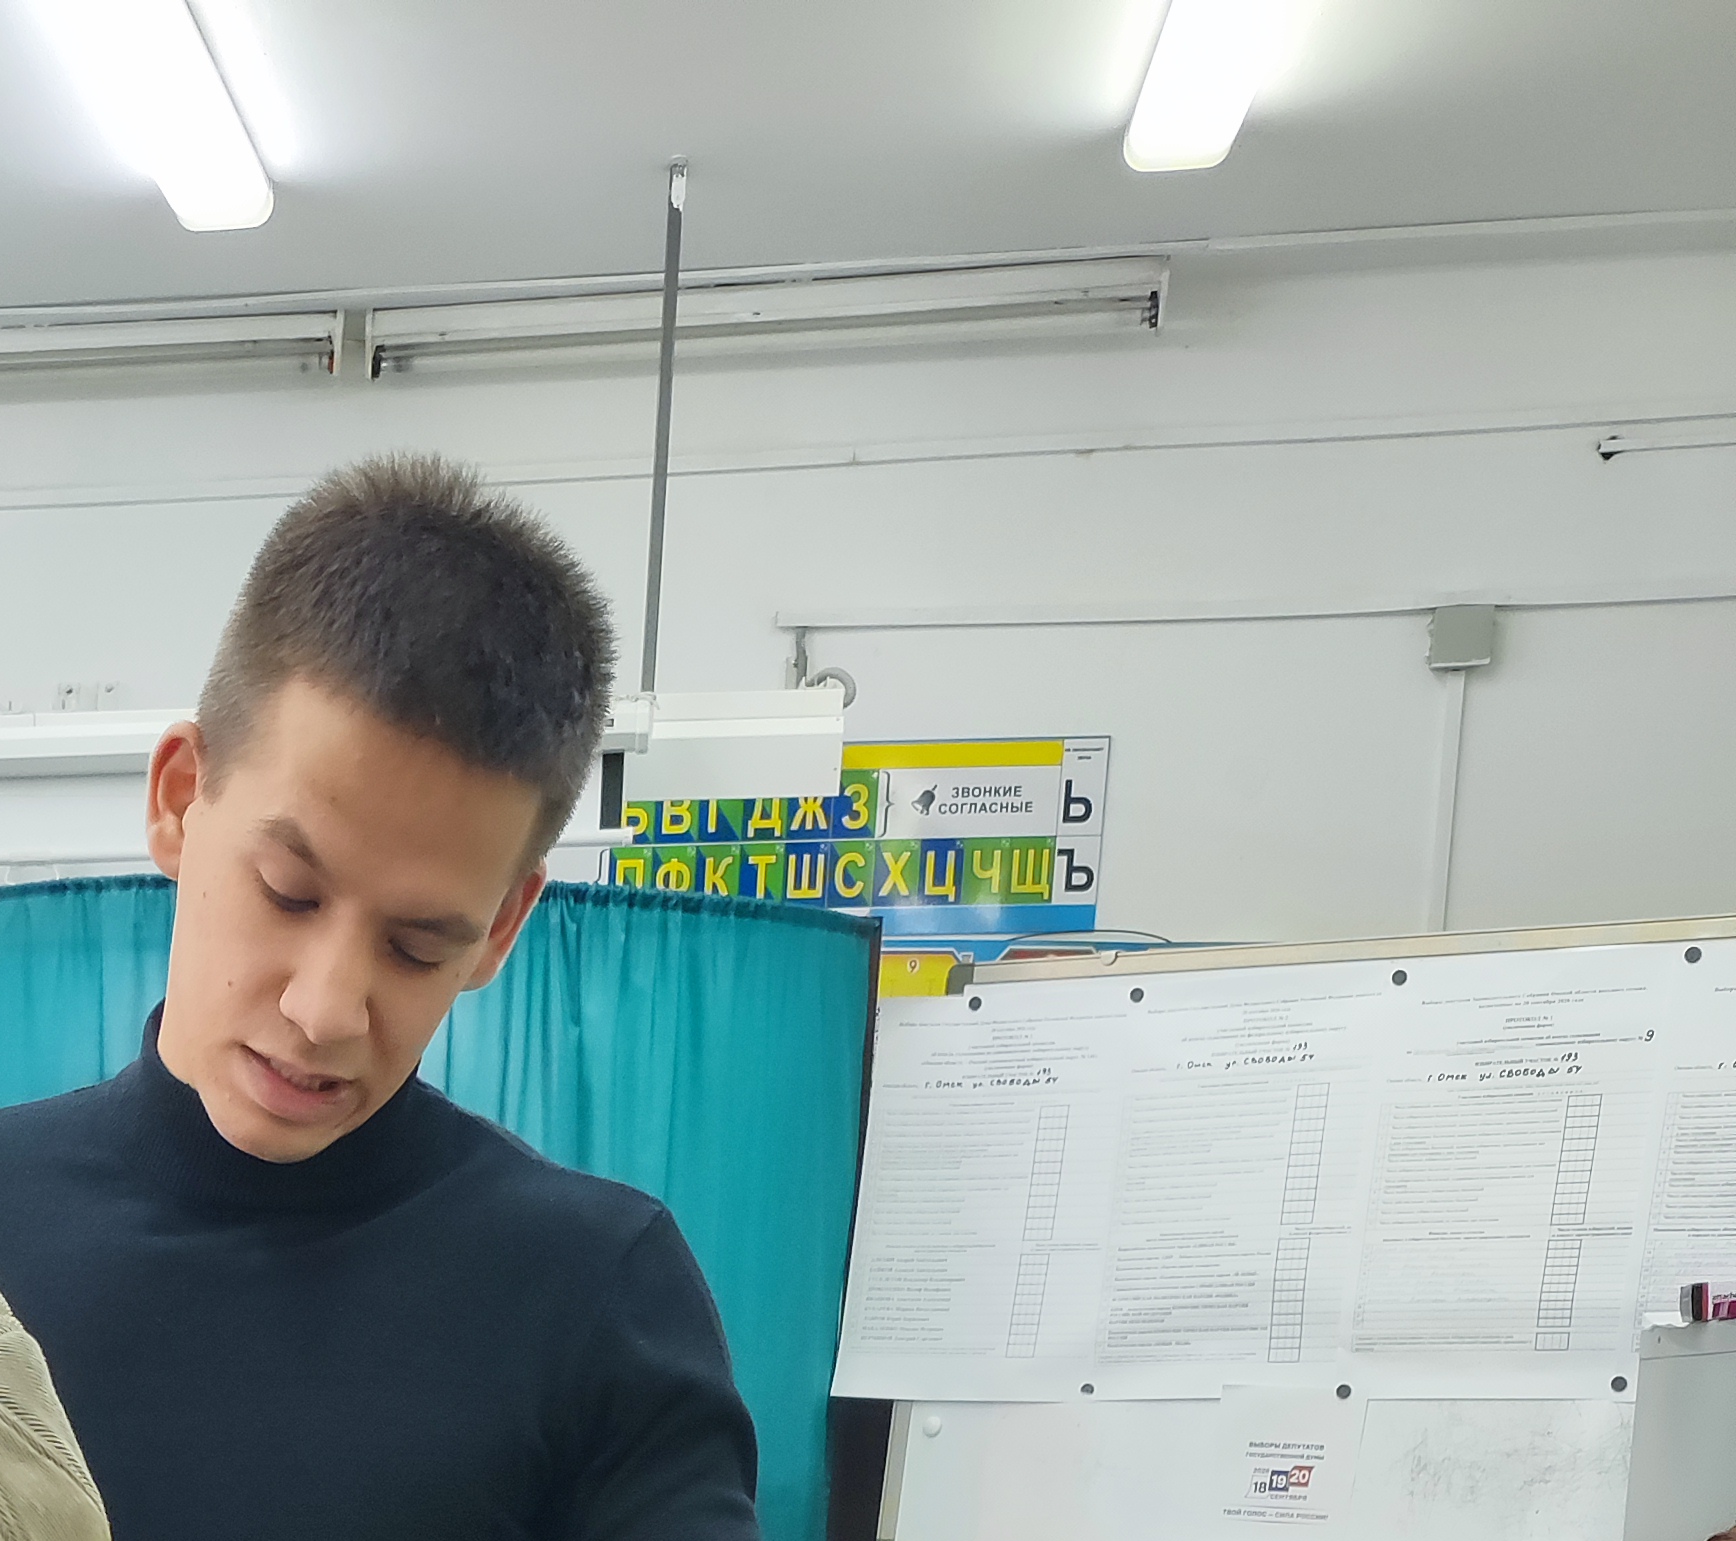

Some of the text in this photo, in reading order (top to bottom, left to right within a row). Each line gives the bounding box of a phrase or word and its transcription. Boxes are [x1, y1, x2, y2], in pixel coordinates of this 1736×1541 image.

[841, 783, 869, 830] З
[938, 801, 1033, 815] СОГЛАСНЫЕ
[951, 785, 1023, 798] ЗВОНКИЕ
[1062, 779, 1092, 823] Ь
[704, 856, 734, 896] К
[748, 855, 777, 899] Т
[786, 854, 825, 899] Ш
[834, 852, 865, 898] С
[879, 851, 911, 896] Х
[924, 850, 956, 902] Ц
[972, 850, 1001, 893] Ч
[1011, 848, 1050, 900] Щ
[1057, 848, 1094, 892] Ъ
[1644, 1029, 1655, 1042] 9
[1253, 1469, 1310, 1494] 18 19 20
